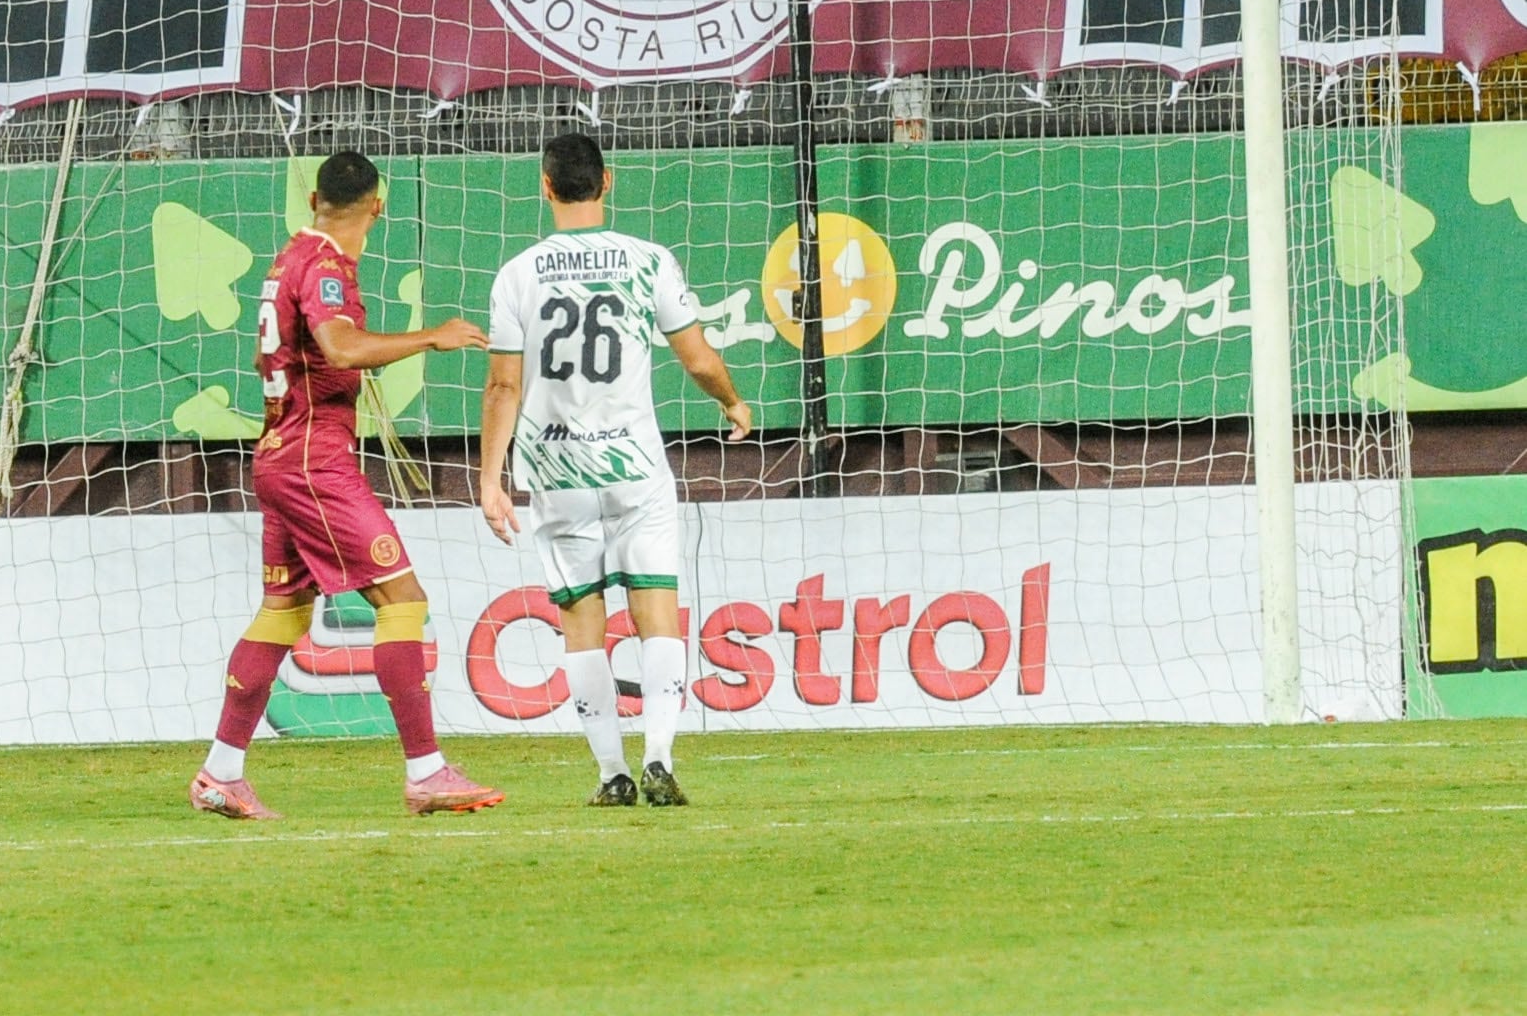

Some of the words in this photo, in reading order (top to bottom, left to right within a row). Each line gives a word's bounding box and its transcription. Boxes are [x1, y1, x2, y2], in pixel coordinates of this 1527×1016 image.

[535, 250, 628, 274] CARMELITA
[903, 221, 1253, 340] Pinos
[540, 294, 625, 384] 26
